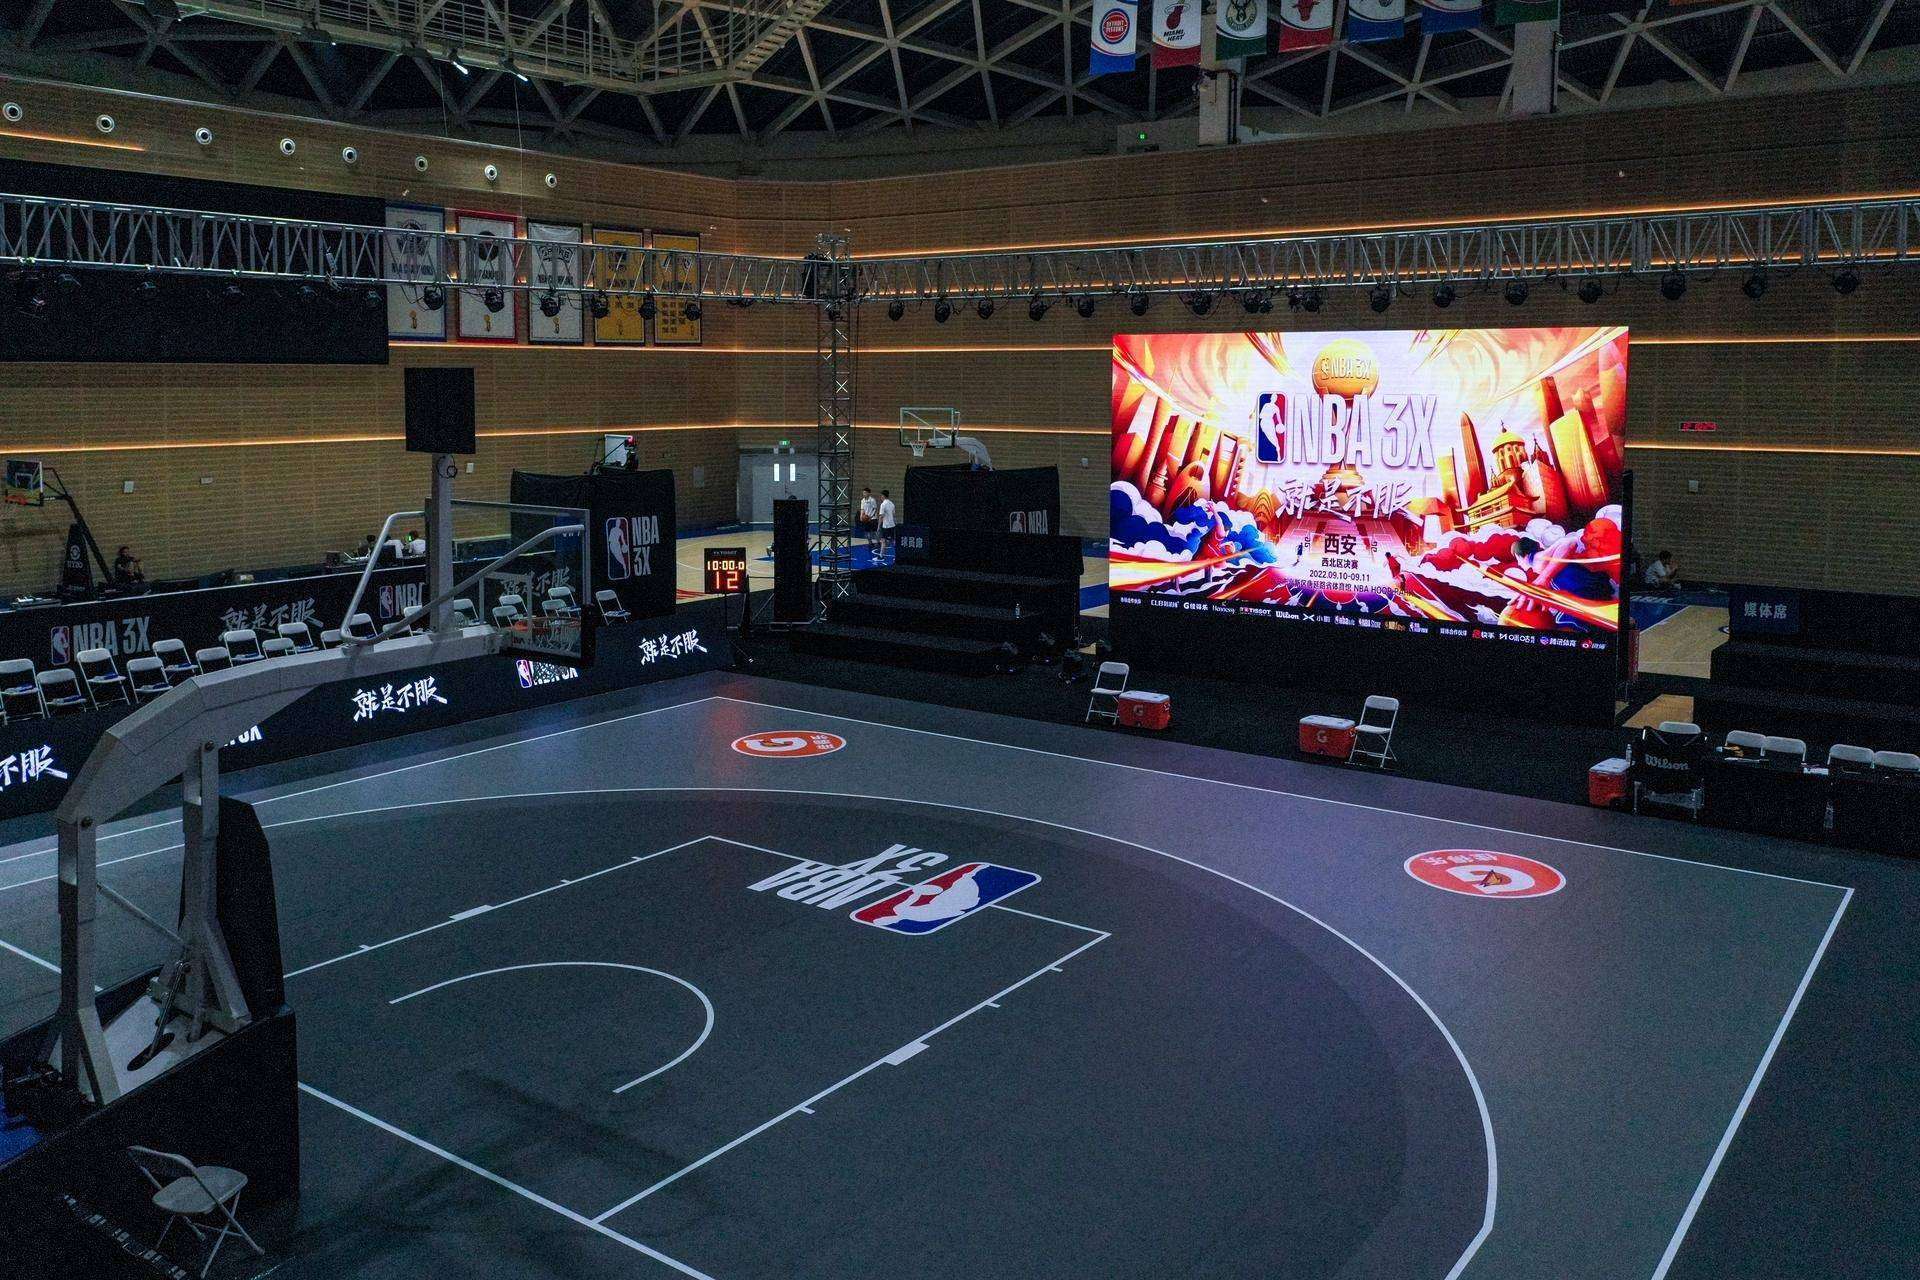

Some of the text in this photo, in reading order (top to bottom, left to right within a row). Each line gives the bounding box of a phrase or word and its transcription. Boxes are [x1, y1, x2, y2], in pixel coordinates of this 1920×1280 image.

[1292, 393, 1437, 468] NBA 3X
[1275, 478, 1424, 526] 就是不服
[631, 515, 660, 546] NBA
[1324, 533, 1357, 556] 西安
[632, 546, 652, 577] 3X
[707, 560, 745, 570] 10:00.0
[1321, 557, 1359, 570] 西北区决赛
[716, 571, 738, 589] 12
[1309, 569, 1371, 582] 2022.09.10-09.11
[1353, 584, 1369, 593] NBA
[1275, 610, 1300, 621] Wilson
[1744, 602, 1788, 619] 媒体席
[73, 616, 151, 662] NBA 3X
[639, 629, 707, 666] 就是不服
[352, 675, 448, 722] 就是不服
[1644, 753, 1690, 770] Wilson
[746, 859, 898, 911] NBA
